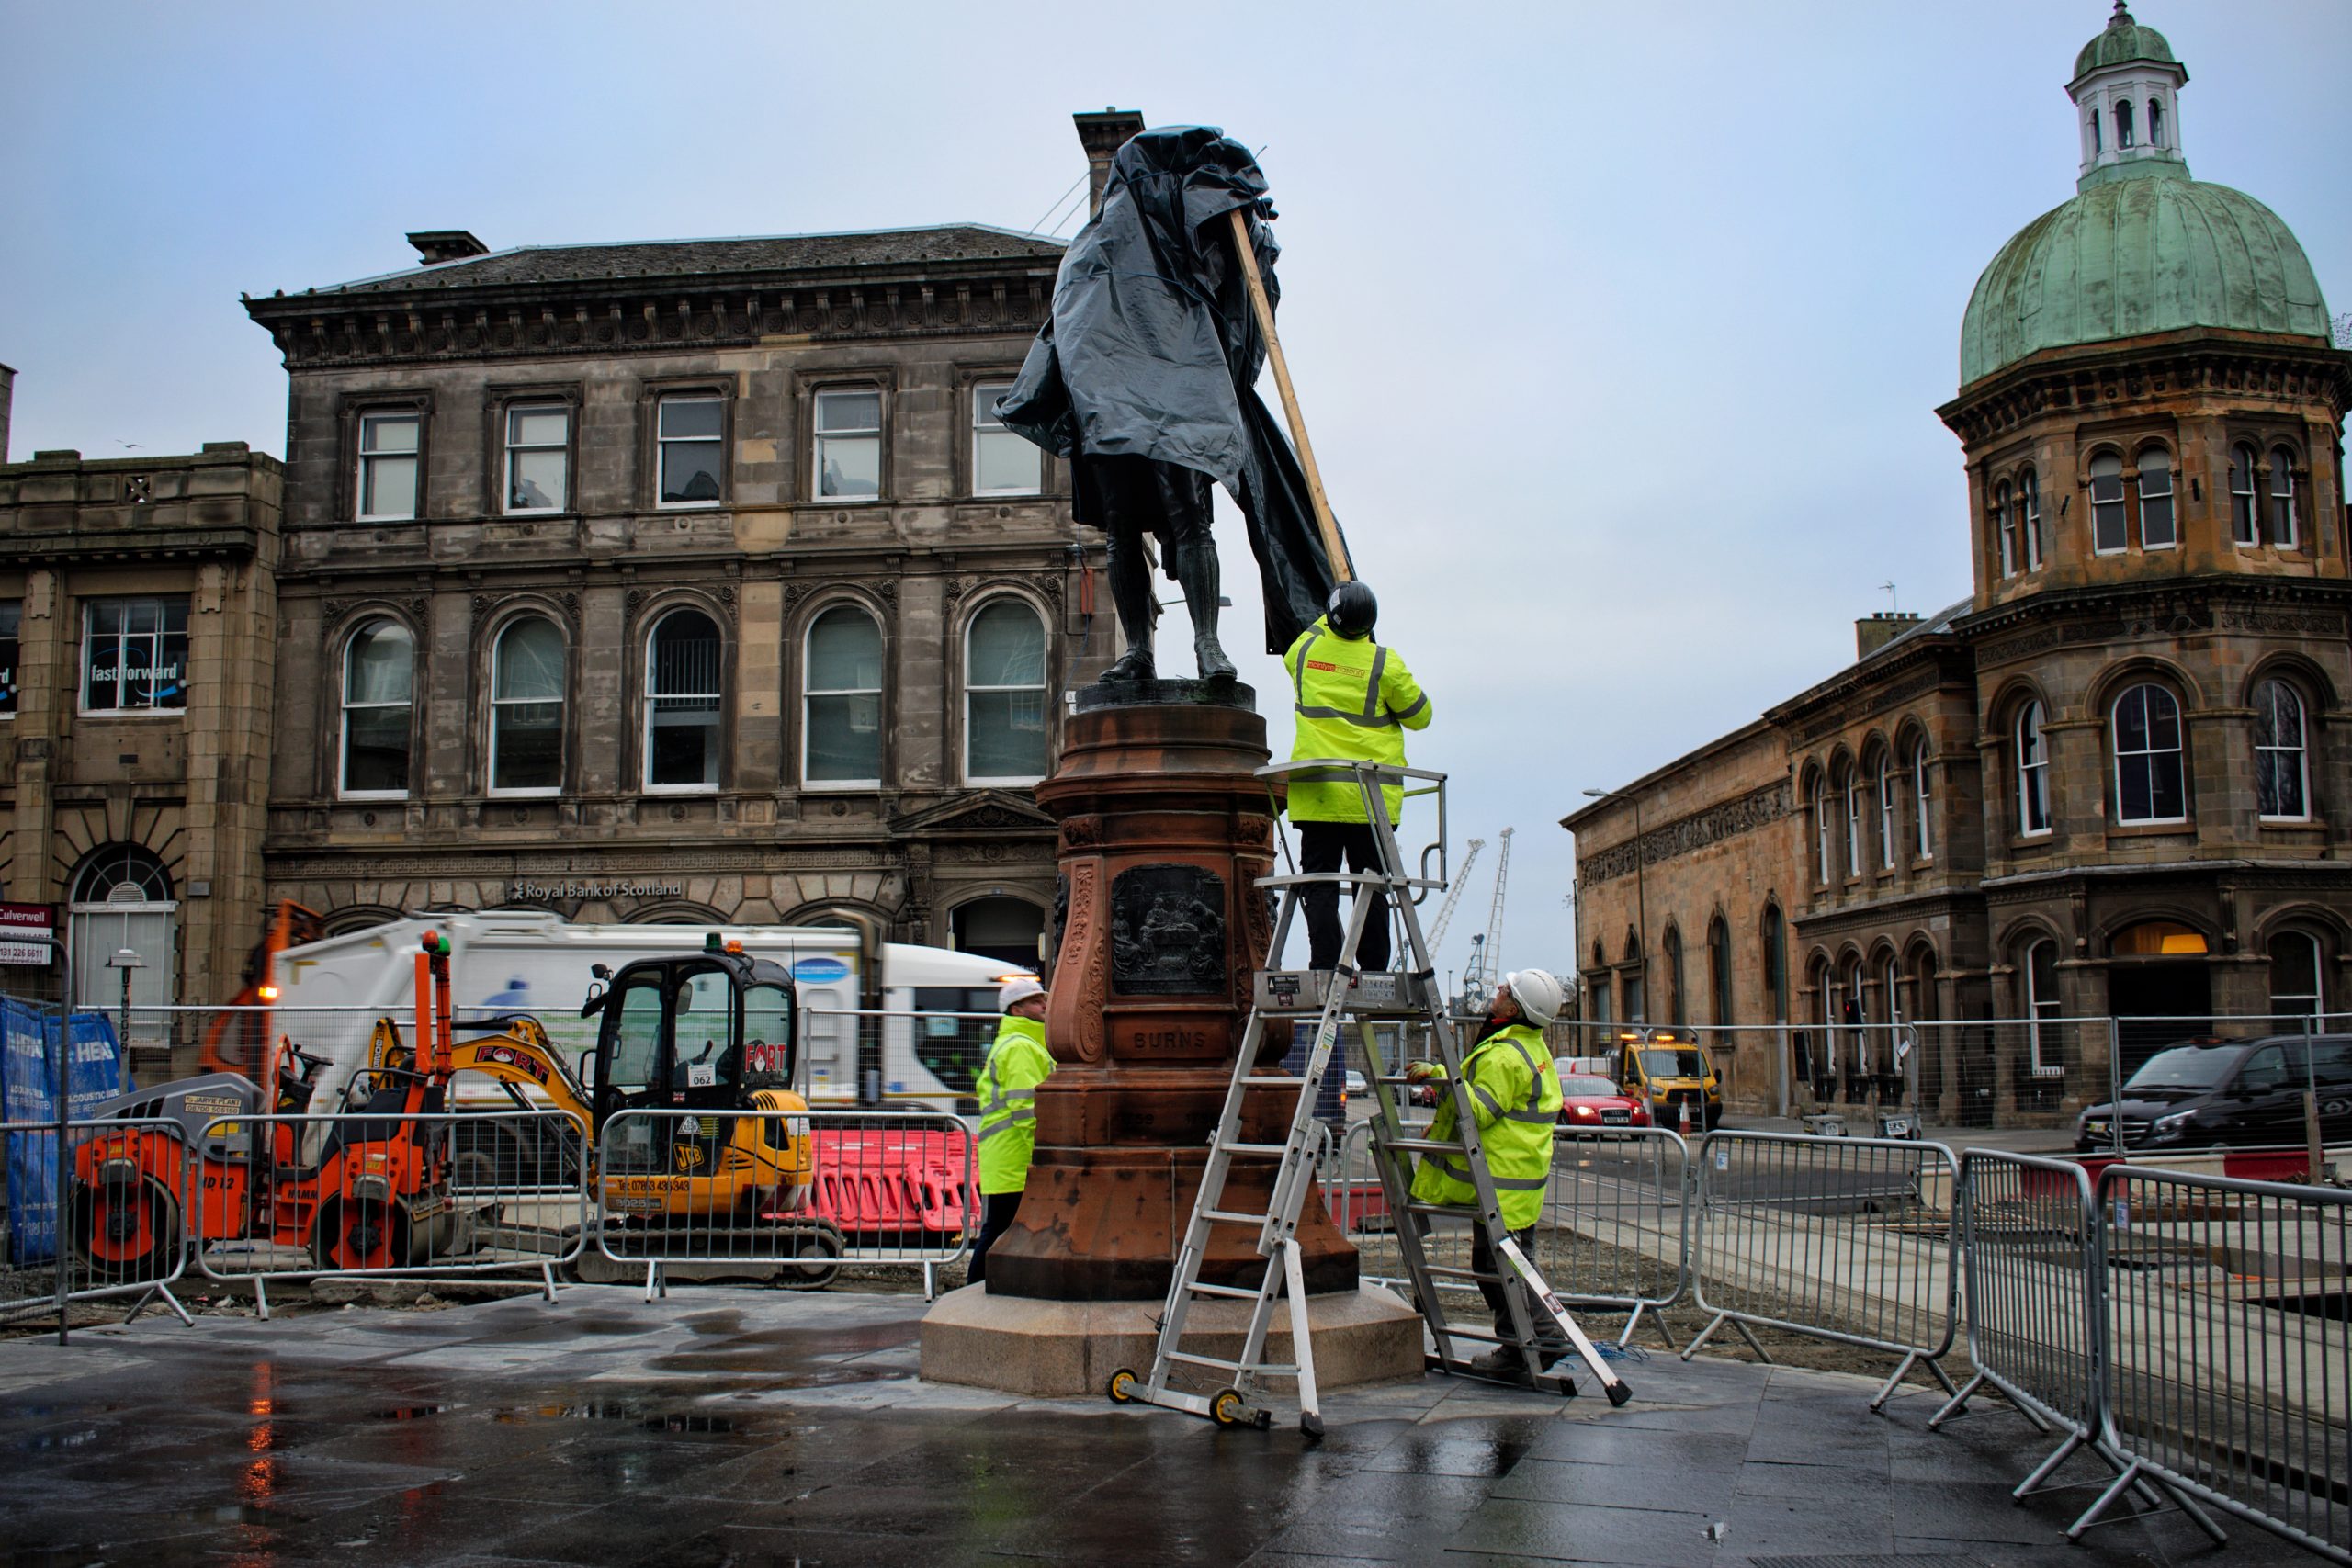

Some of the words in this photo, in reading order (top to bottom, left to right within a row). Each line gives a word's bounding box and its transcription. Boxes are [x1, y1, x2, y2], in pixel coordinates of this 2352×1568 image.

[92, 665, 117, 682] fast
[124, 662, 177, 680] forward
[526, 881, 564, 901] Royal
[568, 884, 602, 897] Bank
[604, 883, 619, 897] of
[621, 881, 681, 896] Scotland
[13, 948, 27, 957] 226
[1134, 1032, 1205, 1049] BURNS
[476, 1046, 548, 1080] FORT
[745, 1043, 786, 1073] FORT
[694, 1076, 711, 1085] 062
[677, 1145, 703, 1169] JCB
